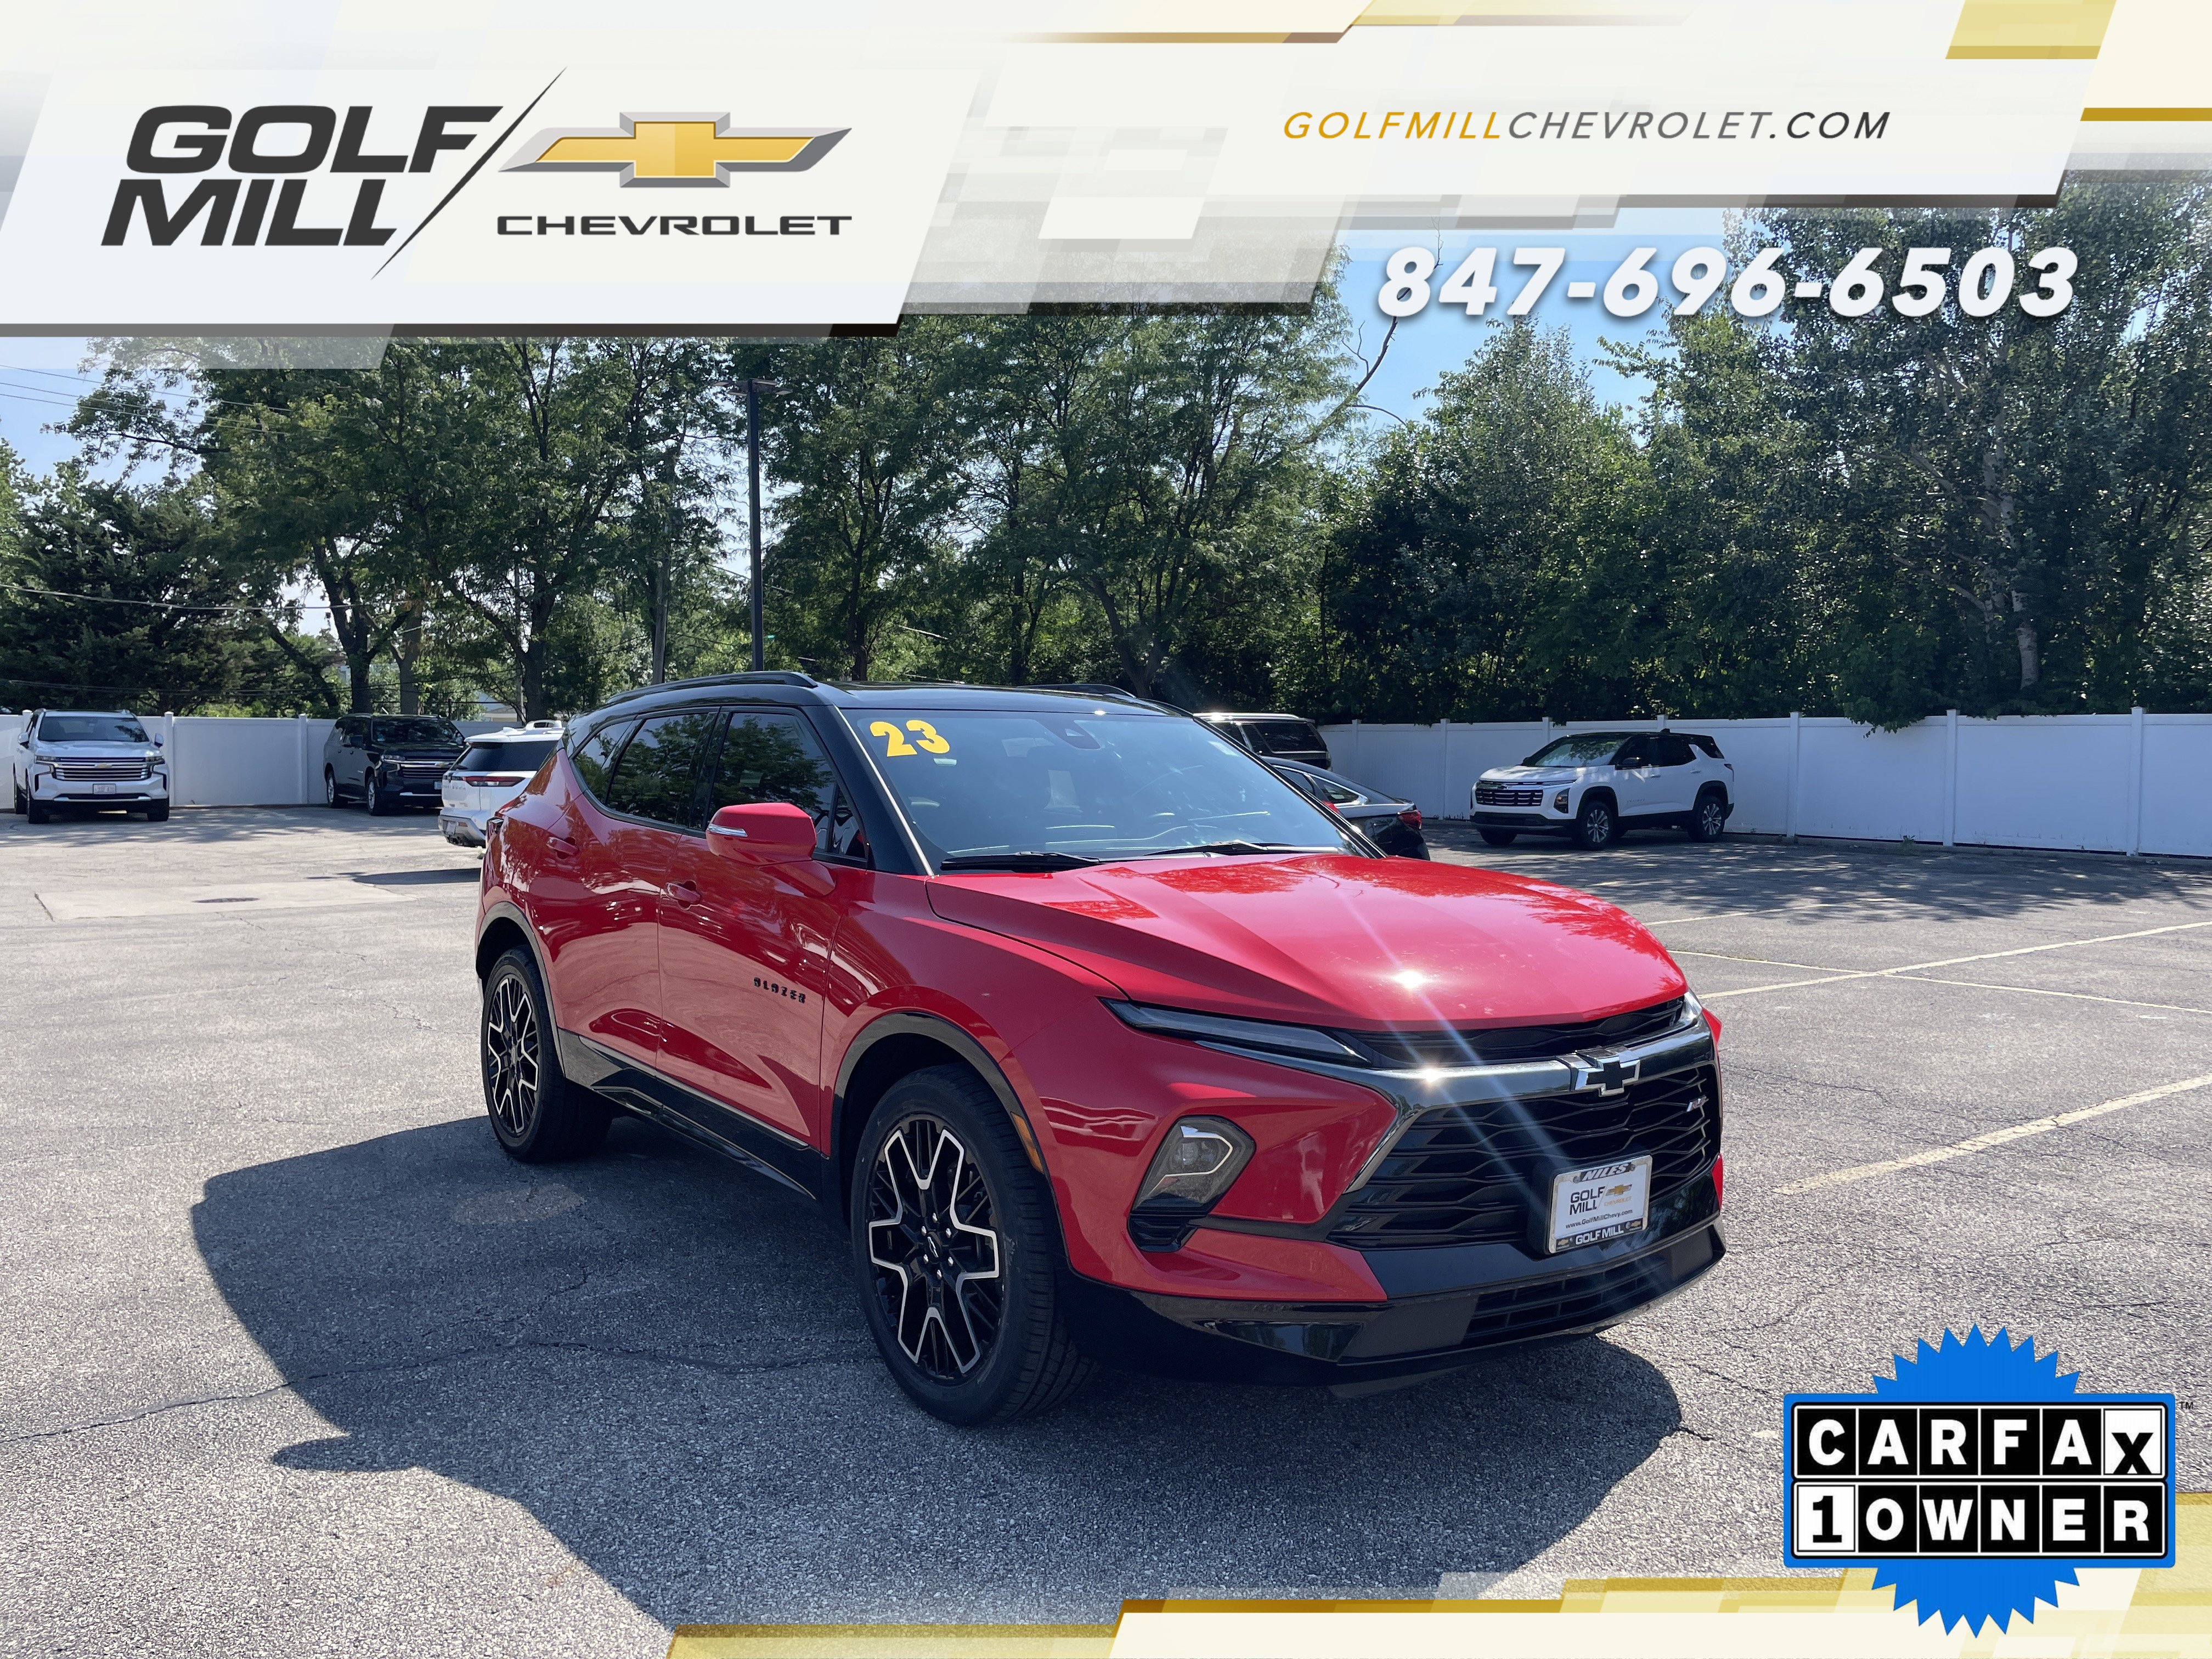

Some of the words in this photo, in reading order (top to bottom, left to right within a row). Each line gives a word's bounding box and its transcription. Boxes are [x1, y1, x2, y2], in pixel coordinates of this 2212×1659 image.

[870, 720, 950, 757] 23
[754, 977, 806, 1003] BLAZER
[1582, 1164, 1627, 1182] NILES
[1571, 1186, 1606, 1203] GOLF
[1570, 1200, 1598, 1215] MILL
[1575, 1231, 1601, 1245] GOLF
[1602, 1225, 1624, 1239] MILL
